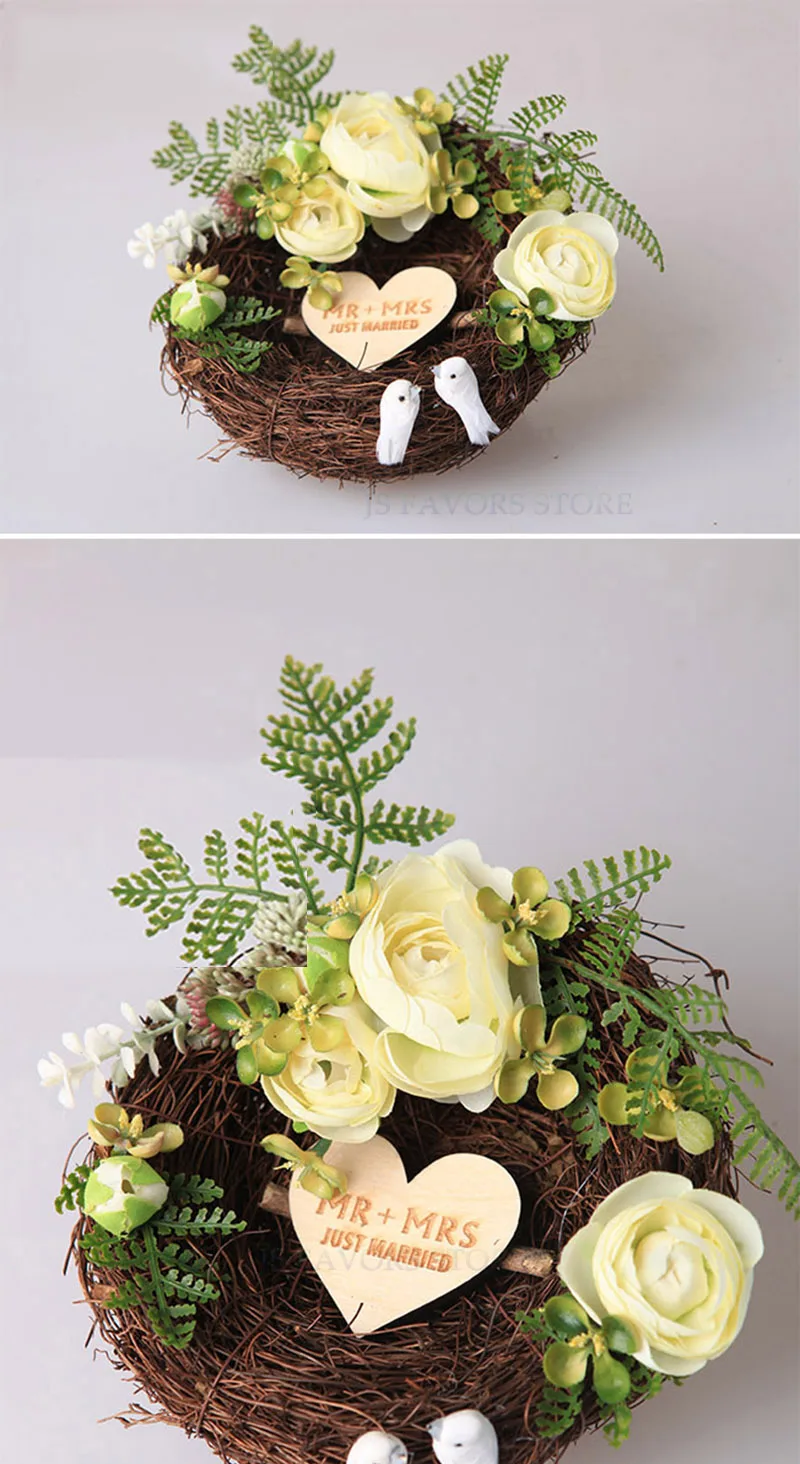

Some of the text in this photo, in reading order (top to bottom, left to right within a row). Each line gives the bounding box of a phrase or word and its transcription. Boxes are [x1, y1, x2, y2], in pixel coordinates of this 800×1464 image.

[380, 298, 433, 317] MRS
[328, 319, 420, 334] JUST MARRIED
[315, 1191, 374, 1228] MR
[400, 1206, 480, 1250] MRS
[319, 1227, 368, 1254] JUST
[366, 1237, 454, 1273] MARRIED
